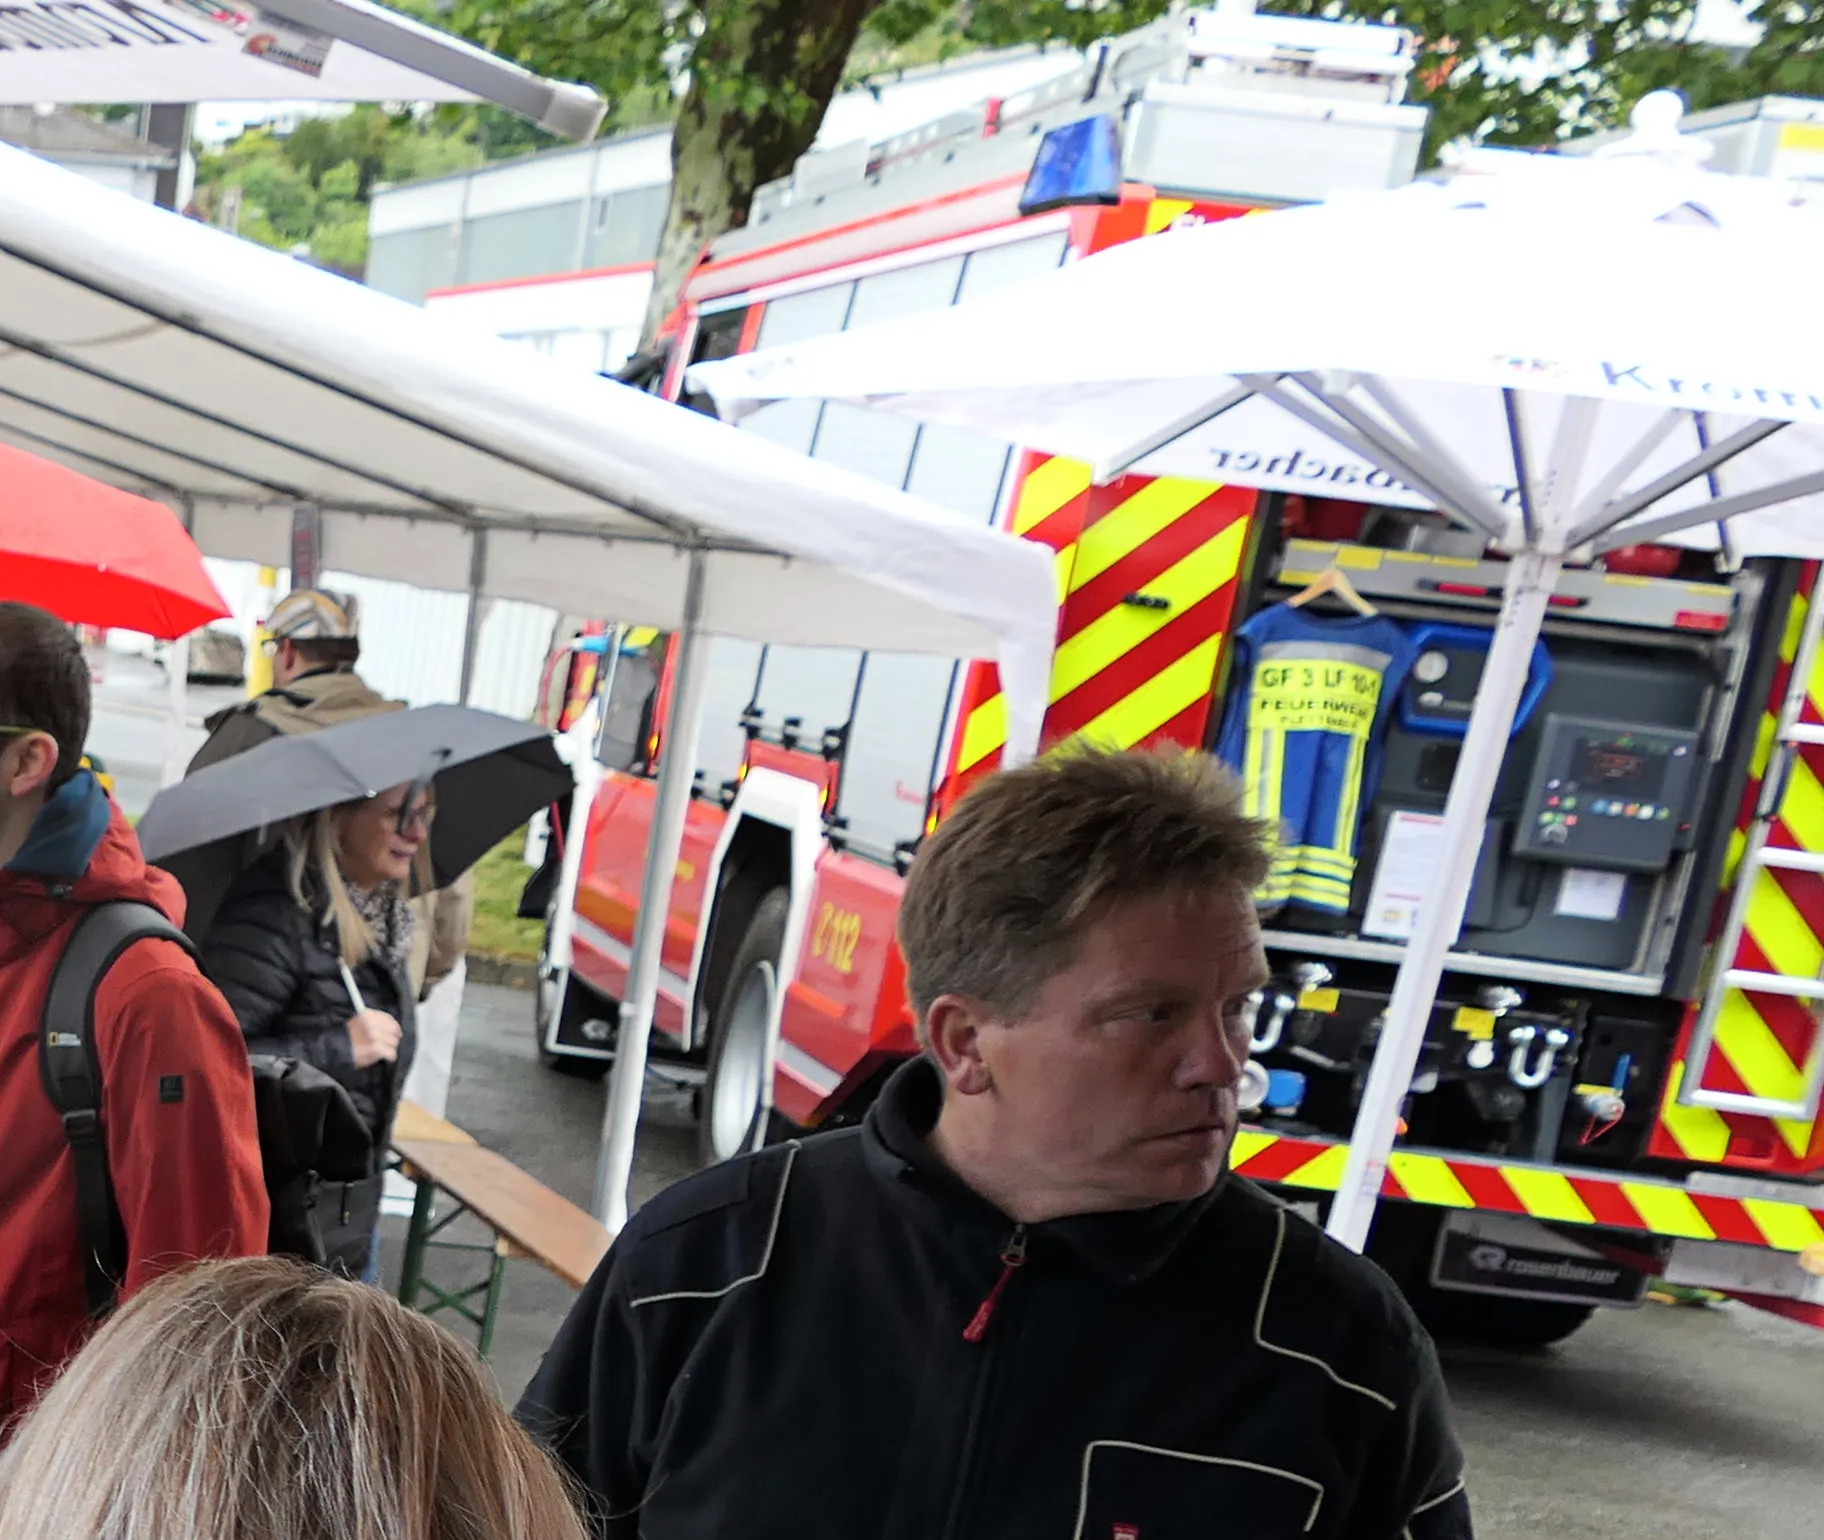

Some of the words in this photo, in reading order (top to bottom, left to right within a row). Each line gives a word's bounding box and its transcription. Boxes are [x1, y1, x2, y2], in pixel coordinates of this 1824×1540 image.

[1262, 668, 1292, 687] GF
[1303, 668, 1314, 687] 3
[1325, 670, 1346, 687] LF
[826, 910, 861, 976] 112
[1507, 1258, 1621, 1286] rosenbauer
